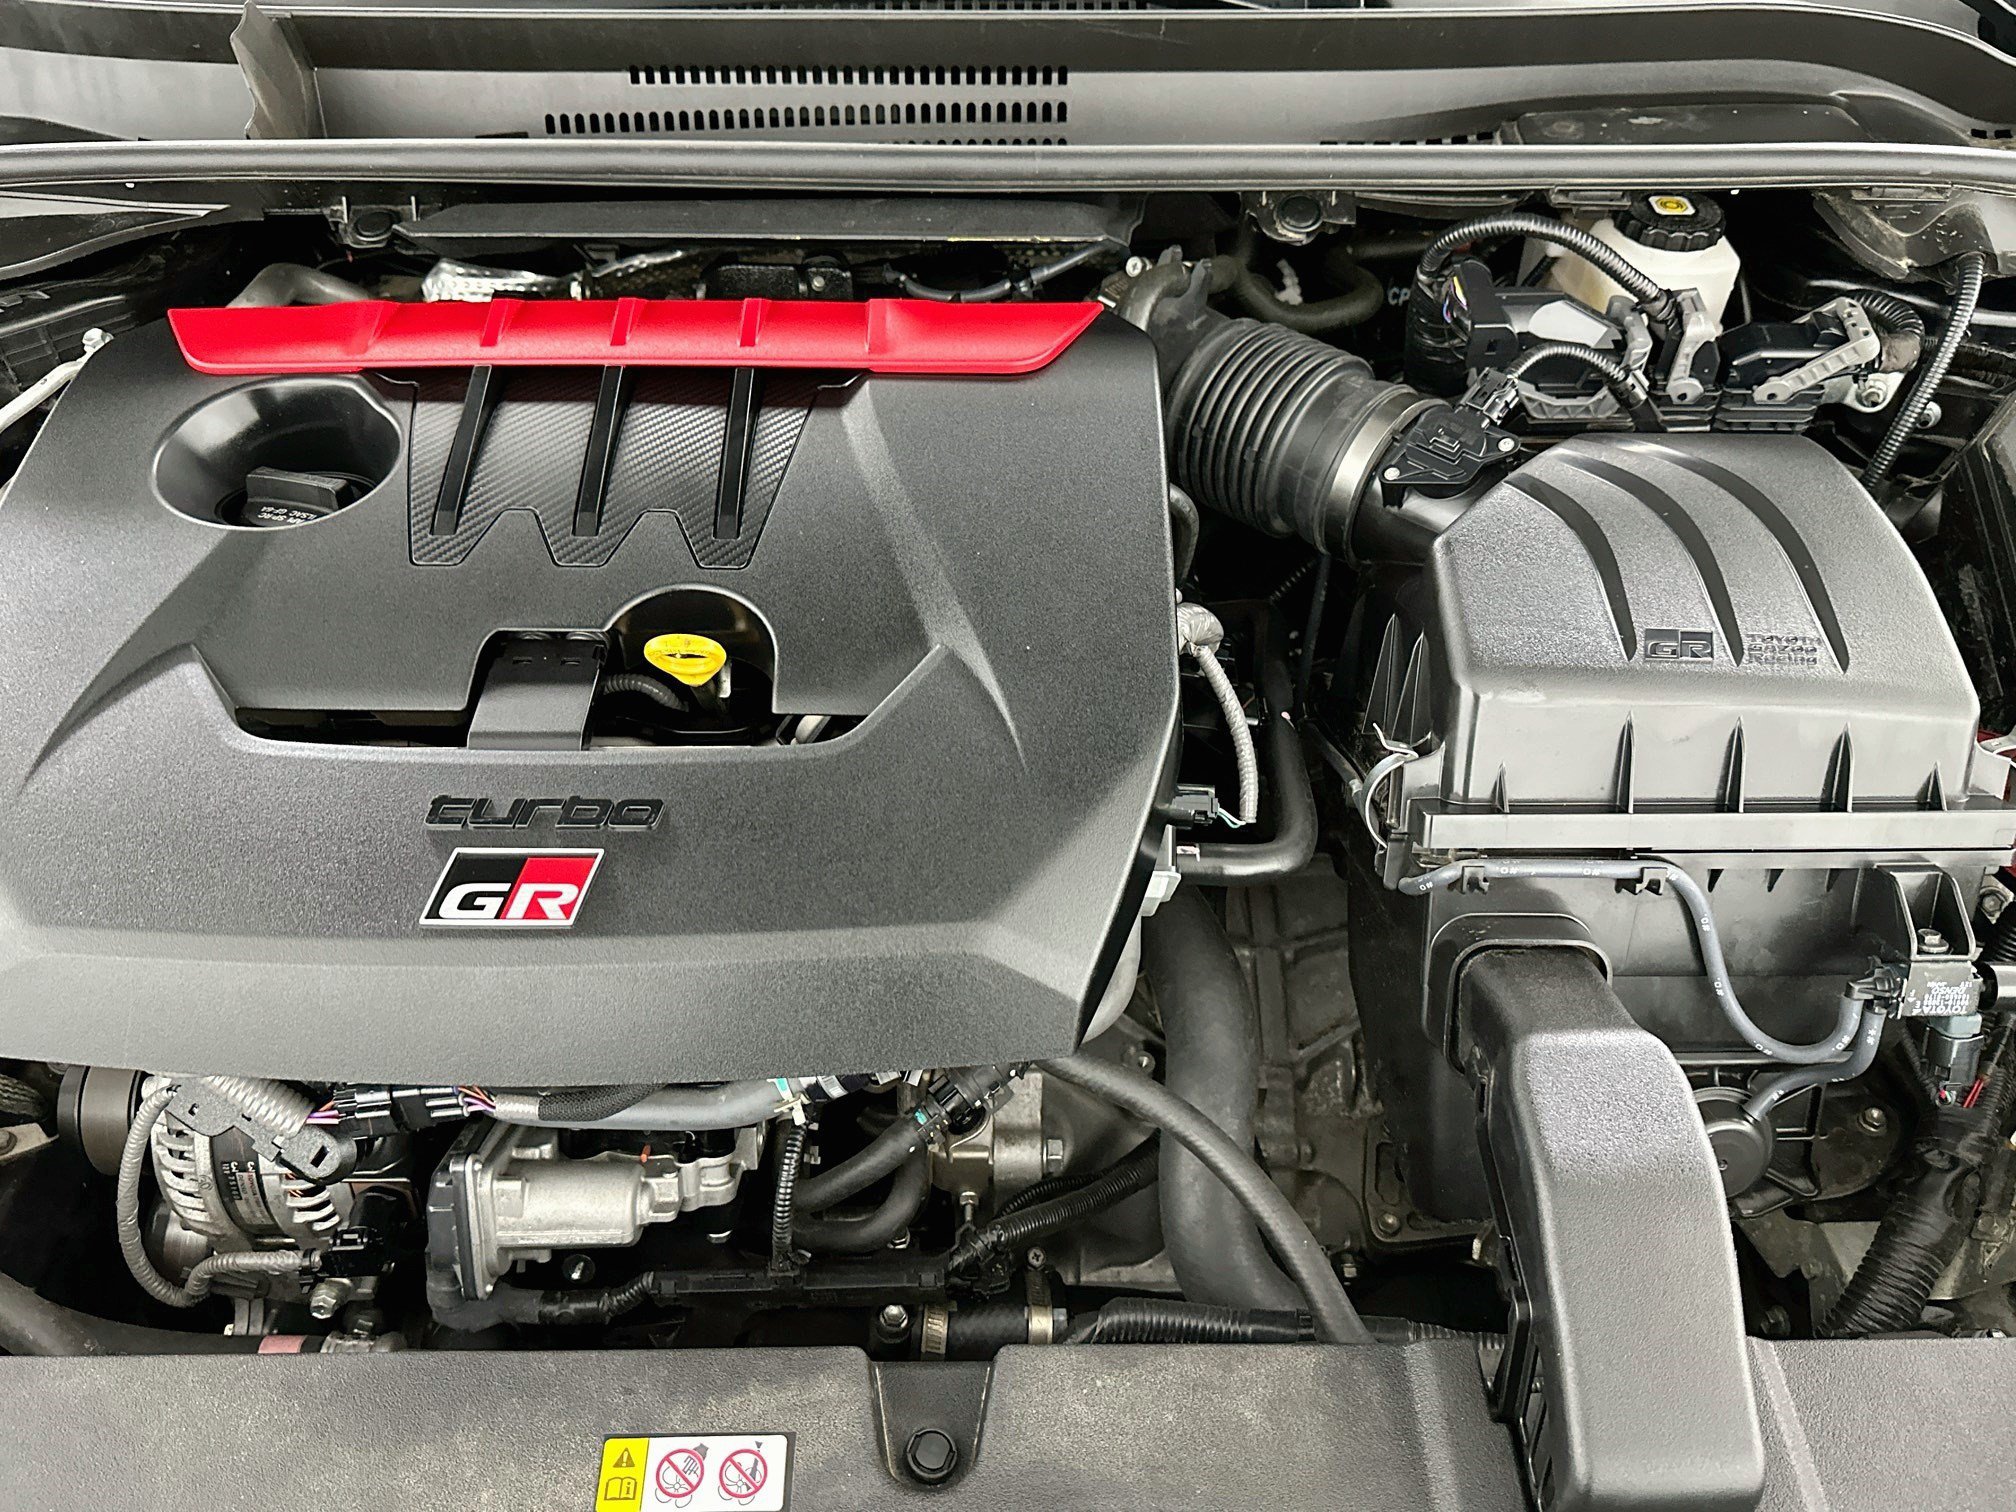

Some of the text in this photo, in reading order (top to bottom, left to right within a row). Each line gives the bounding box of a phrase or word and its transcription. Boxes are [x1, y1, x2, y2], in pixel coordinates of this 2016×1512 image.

[1647, 640, 1713, 659] GR
[424, 794, 666, 831] turbo
[437, 882, 580, 920] GR
[1931, 986, 1967, 994] DENSO
[1922, 1005, 1967, 1014] TOYOTA
